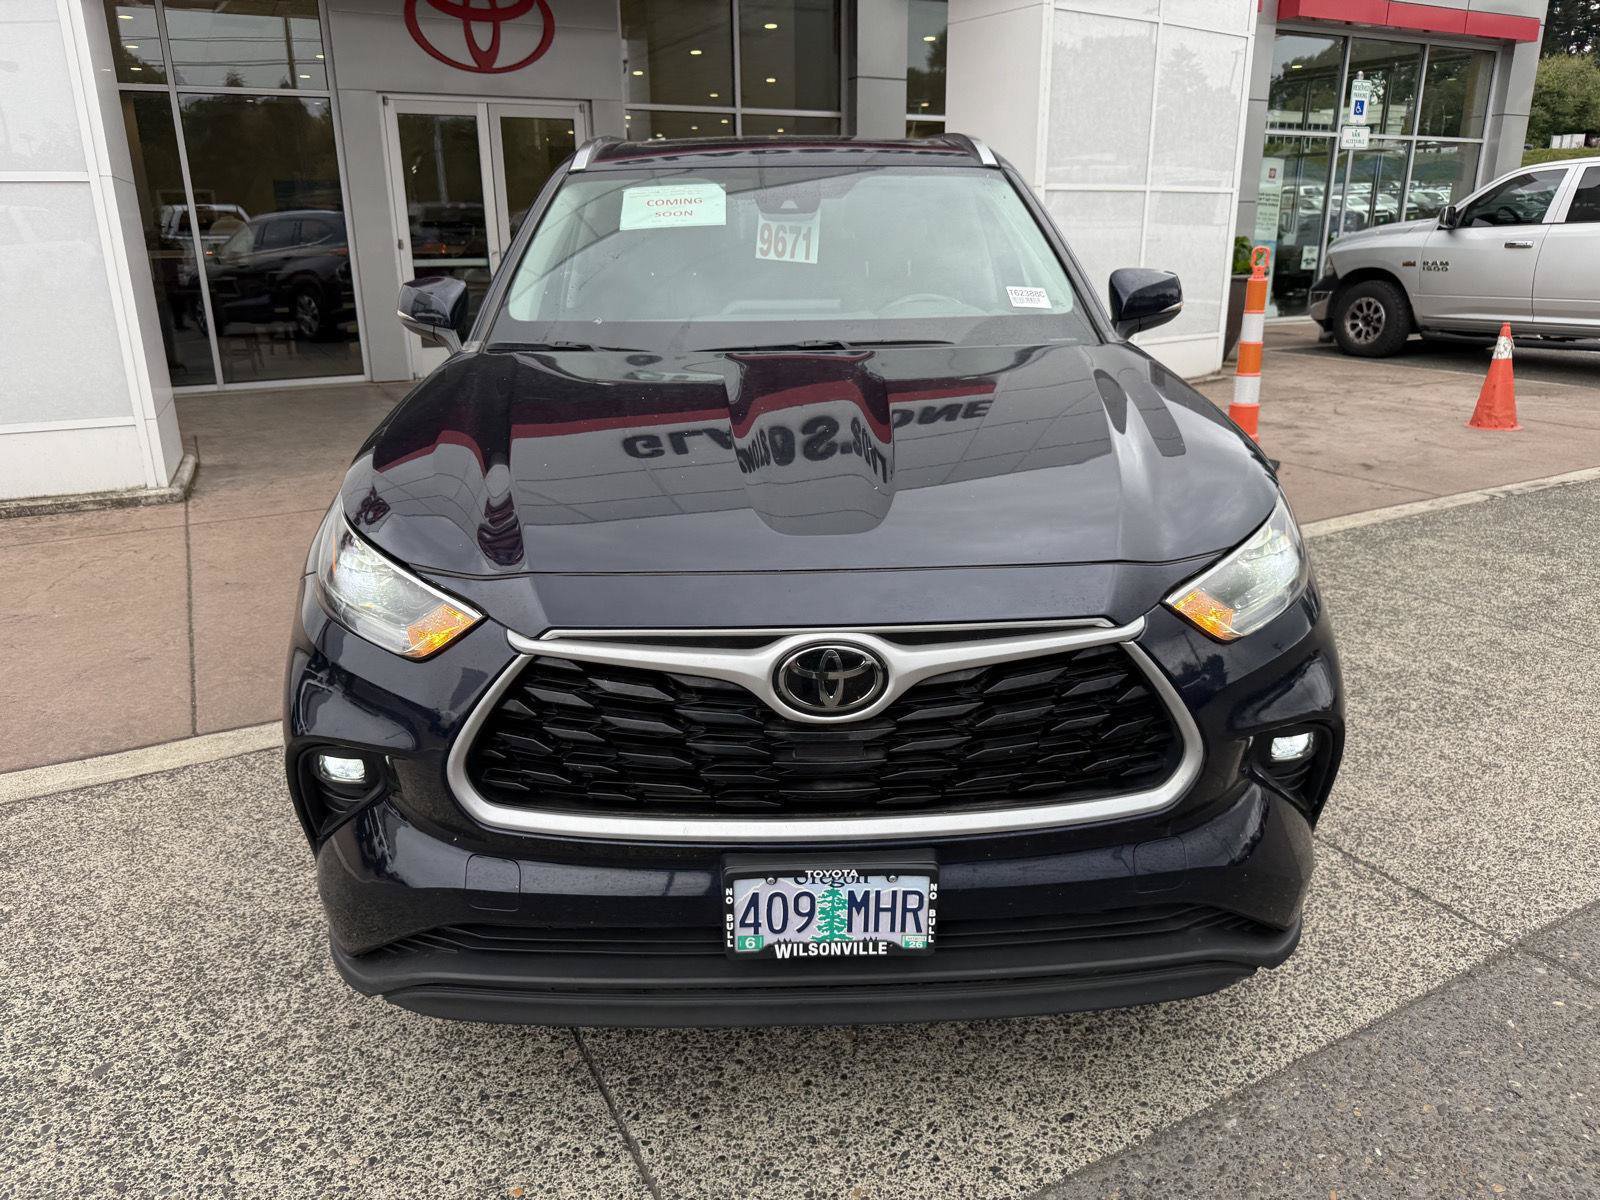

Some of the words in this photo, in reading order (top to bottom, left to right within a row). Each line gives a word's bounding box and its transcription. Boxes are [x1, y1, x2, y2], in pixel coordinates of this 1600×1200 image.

[646, 197, 703, 207] COMING
[655, 209, 693, 217] SOON
[759, 223, 813, 261] 9671
[805, 869, 859, 878] TOYOTA
[725, 887, 733, 905] NO
[929, 883, 938, 900] NO
[739, 890, 817, 935] 409
[846, 889, 925, 933] MHR
[726, 914, 734, 948] BULL
[928, 909, 936, 943] BULL
[744, 936, 756, 949] 6
[774, 941, 888, 959] WILSONVILLE
